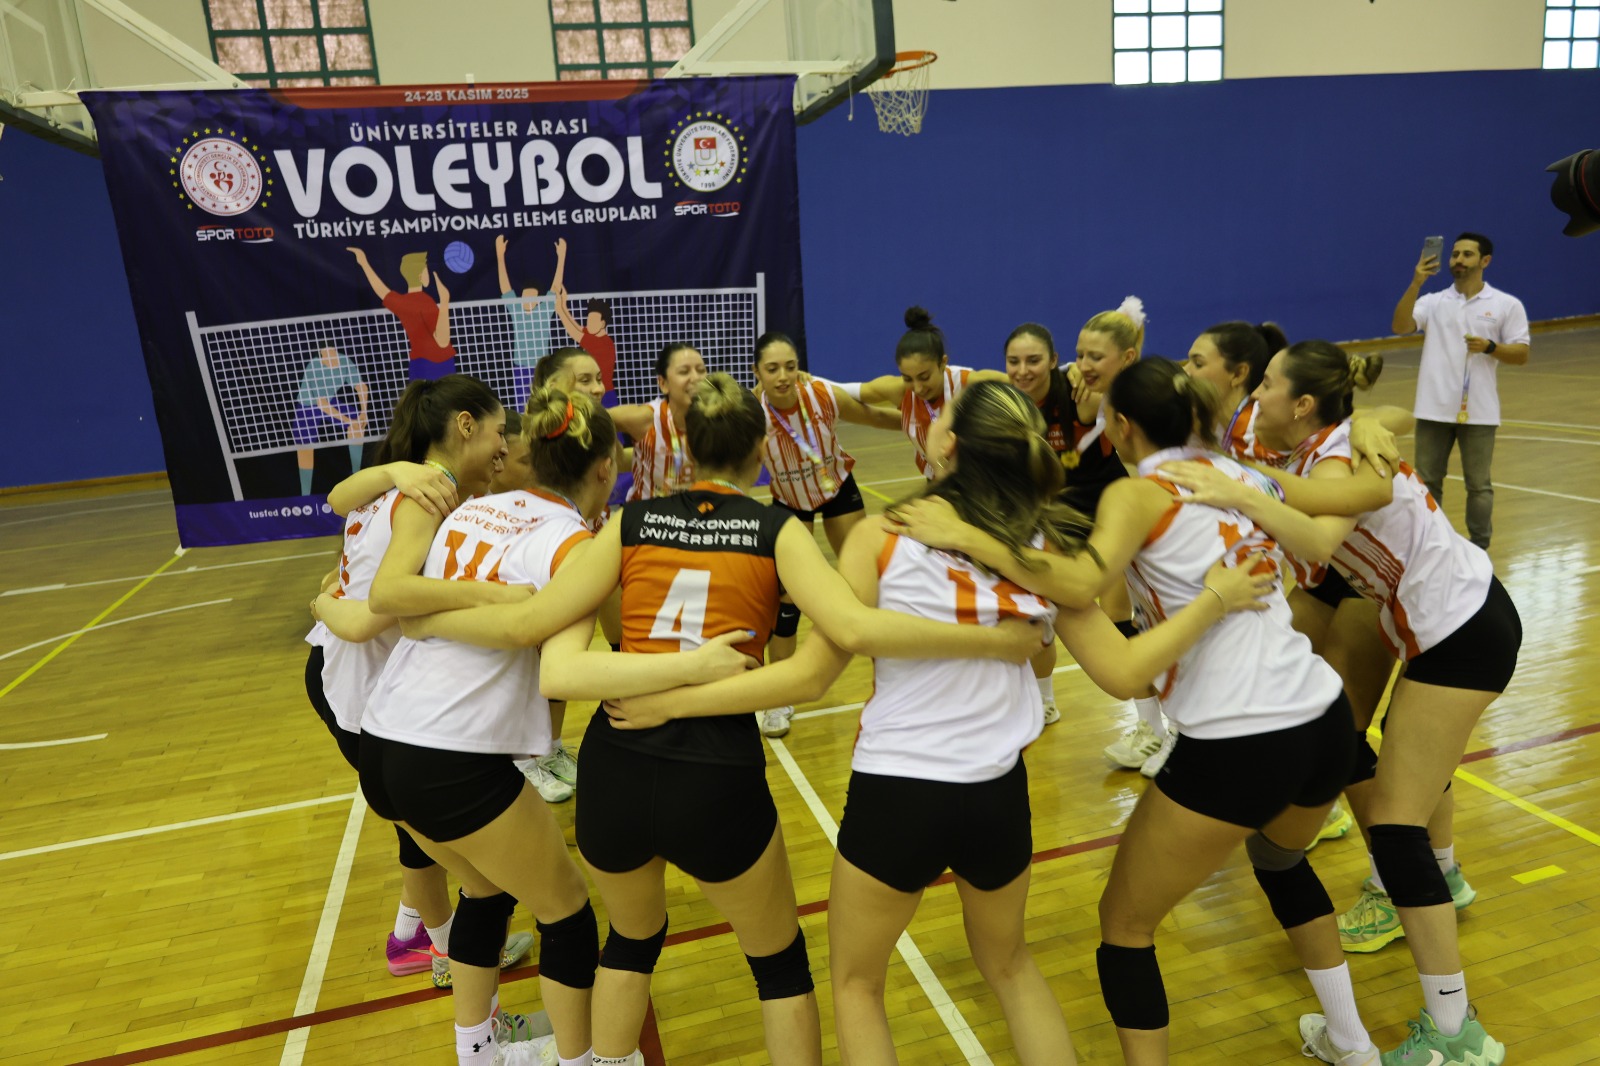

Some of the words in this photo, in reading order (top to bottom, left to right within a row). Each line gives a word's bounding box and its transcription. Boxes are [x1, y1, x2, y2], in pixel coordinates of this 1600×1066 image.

[404, 90, 443, 102] 24-28
[447, 89, 492, 101] KASIM
[496, 88, 529, 100] 2025
[350, 118, 518, 142] ÜNİVERSİTELER
[526, 118, 588, 136] ARASI
[273, 136, 663, 218] VOLEYBOL
[294, 217, 376, 239] TÜRKİYE
[380, 212, 509, 238] ŞAMPİYONASI
[513, 210, 567, 228] ELEME
[571, 205, 657, 223] GRUPLARI
[249, 509, 279, 518] tusfed
[643, 510, 687, 529] İZMİR
[639, 526, 758, 547] ÜNİVERSİTESİ
[648, 568, 711, 652] 4
